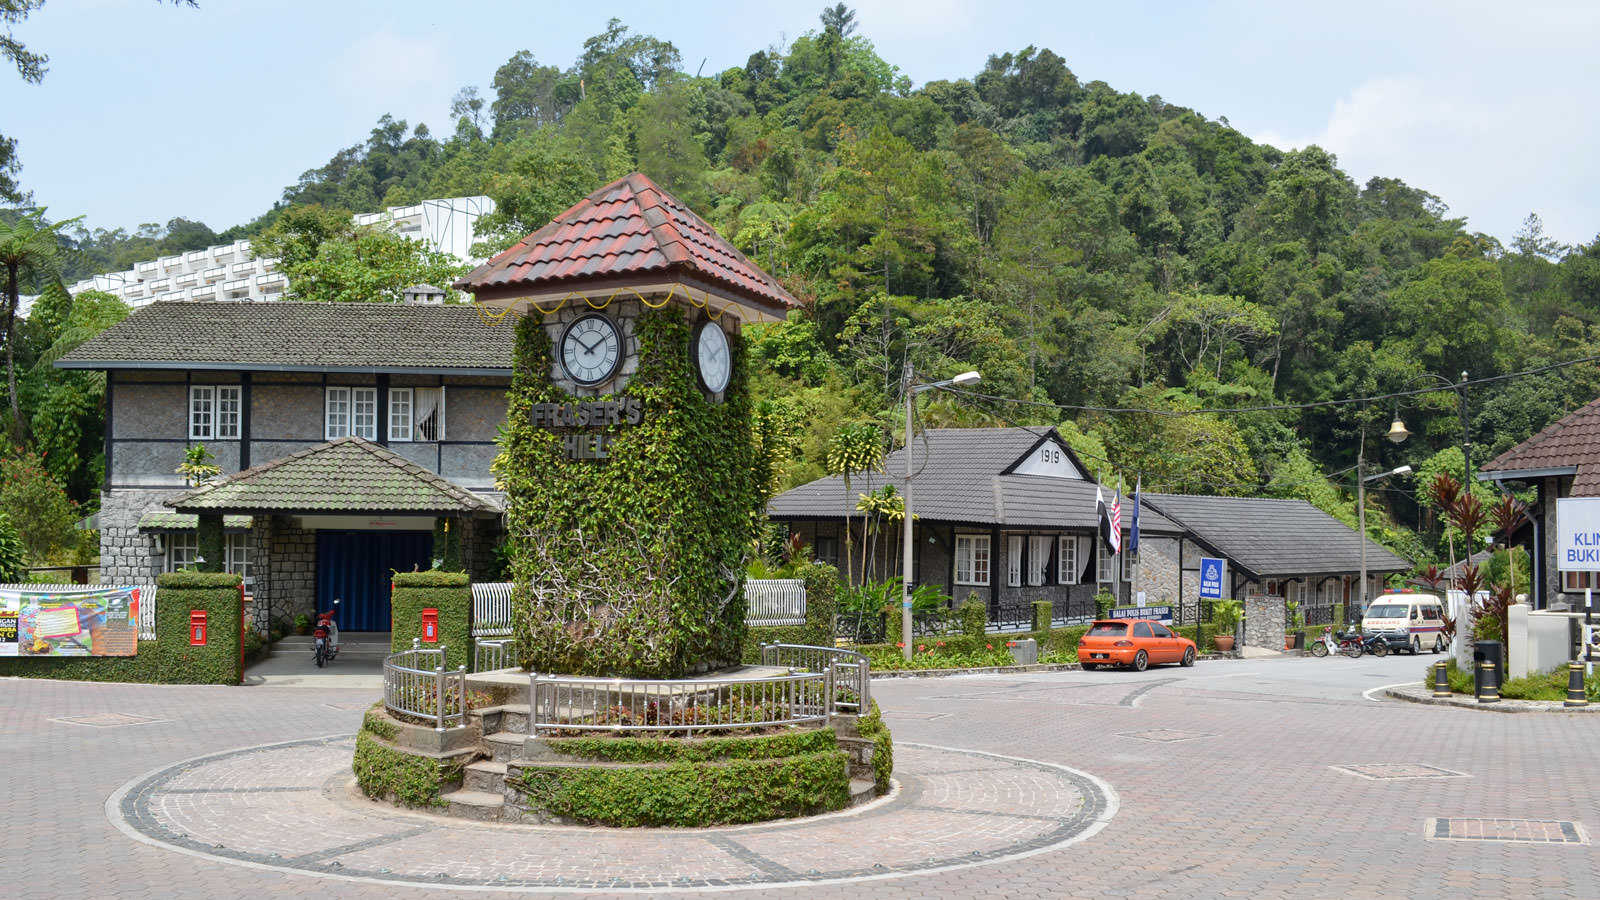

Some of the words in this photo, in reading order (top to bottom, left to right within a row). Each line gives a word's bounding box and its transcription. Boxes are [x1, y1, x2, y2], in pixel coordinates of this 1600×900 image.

[531, 397, 641, 427] FRASER'S
[564, 434, 608, 459] HILL
[1041, 449, 1060, 464] 1919
[1567, 549, 1600, 562] BUKI
[1127, 609, 1139, 617] POLIS
[1153, 606, 1168, 615] FRASER
